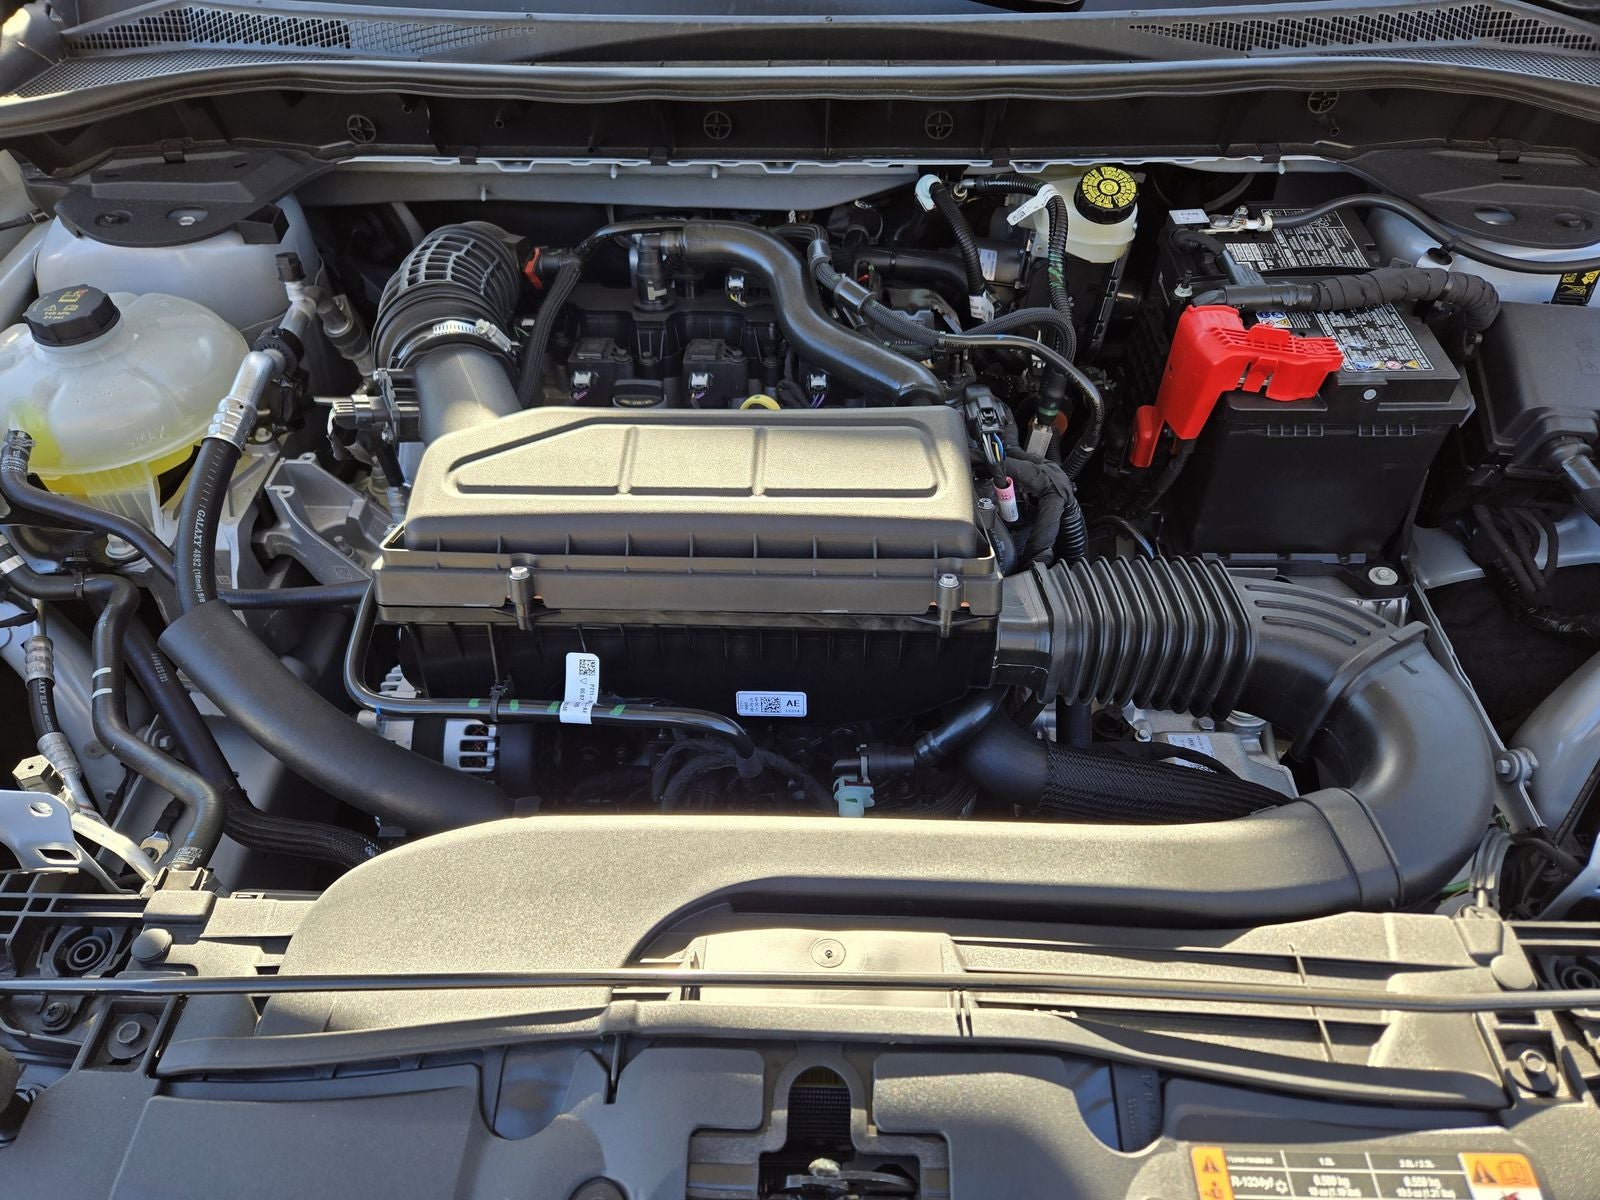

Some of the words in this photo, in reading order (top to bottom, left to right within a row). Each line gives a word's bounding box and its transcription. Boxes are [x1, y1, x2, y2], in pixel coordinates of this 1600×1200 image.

[193, 509, 206, 548] GALAXY
[192, 549, 202, 567] 4882
[192, 569, 204, 592] (16mm)
[786, 699, 800, 707] AE
[1230, 1175, 1275, 1190] R-1234yf
